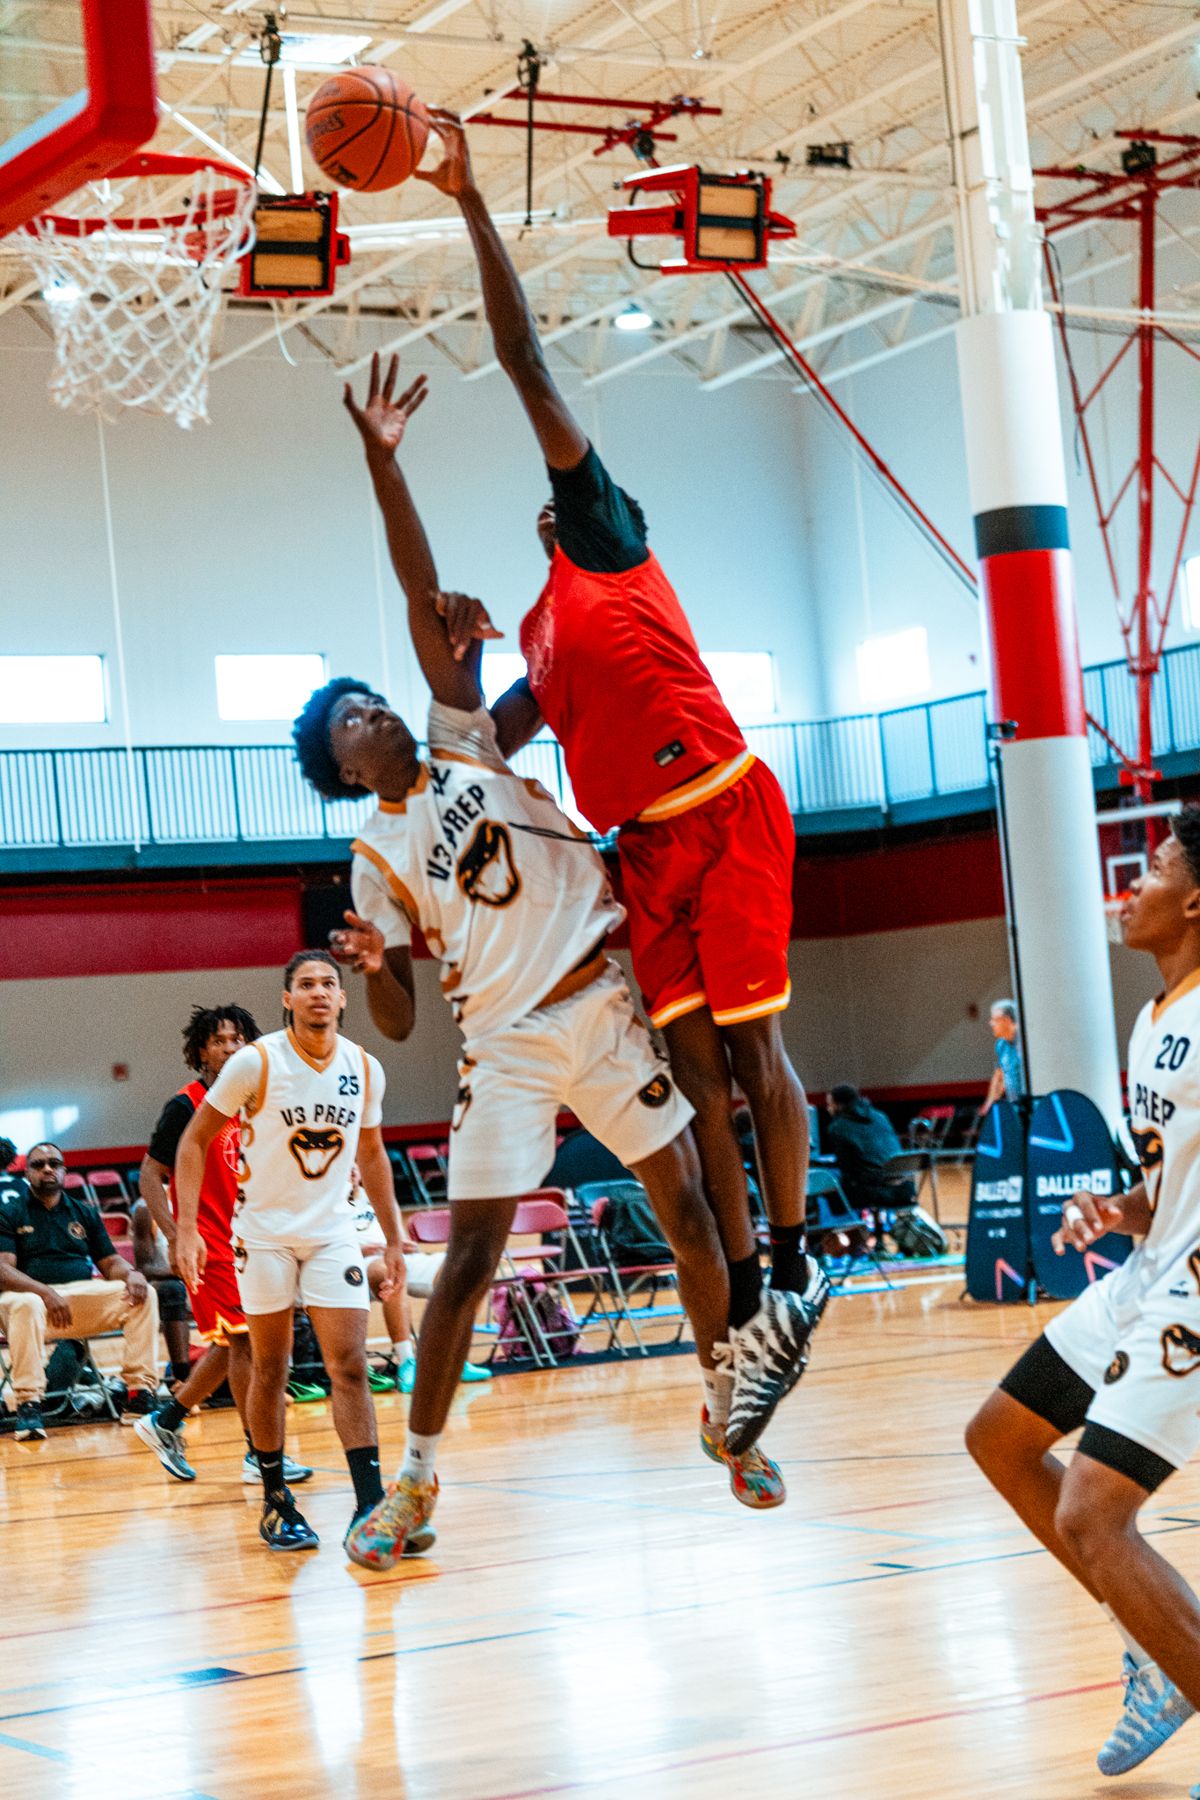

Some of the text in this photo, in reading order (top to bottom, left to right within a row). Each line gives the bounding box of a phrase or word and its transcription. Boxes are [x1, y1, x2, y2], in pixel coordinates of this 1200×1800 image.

[427, 844, 452, 881] V3
[1154, 1034, 1190, 1071] 20
[338, 1075, 359, 1096] 25
[280, 1104, 356, 1127] V3 PREP
[1134, 1083, 1176, 1127] PREP
